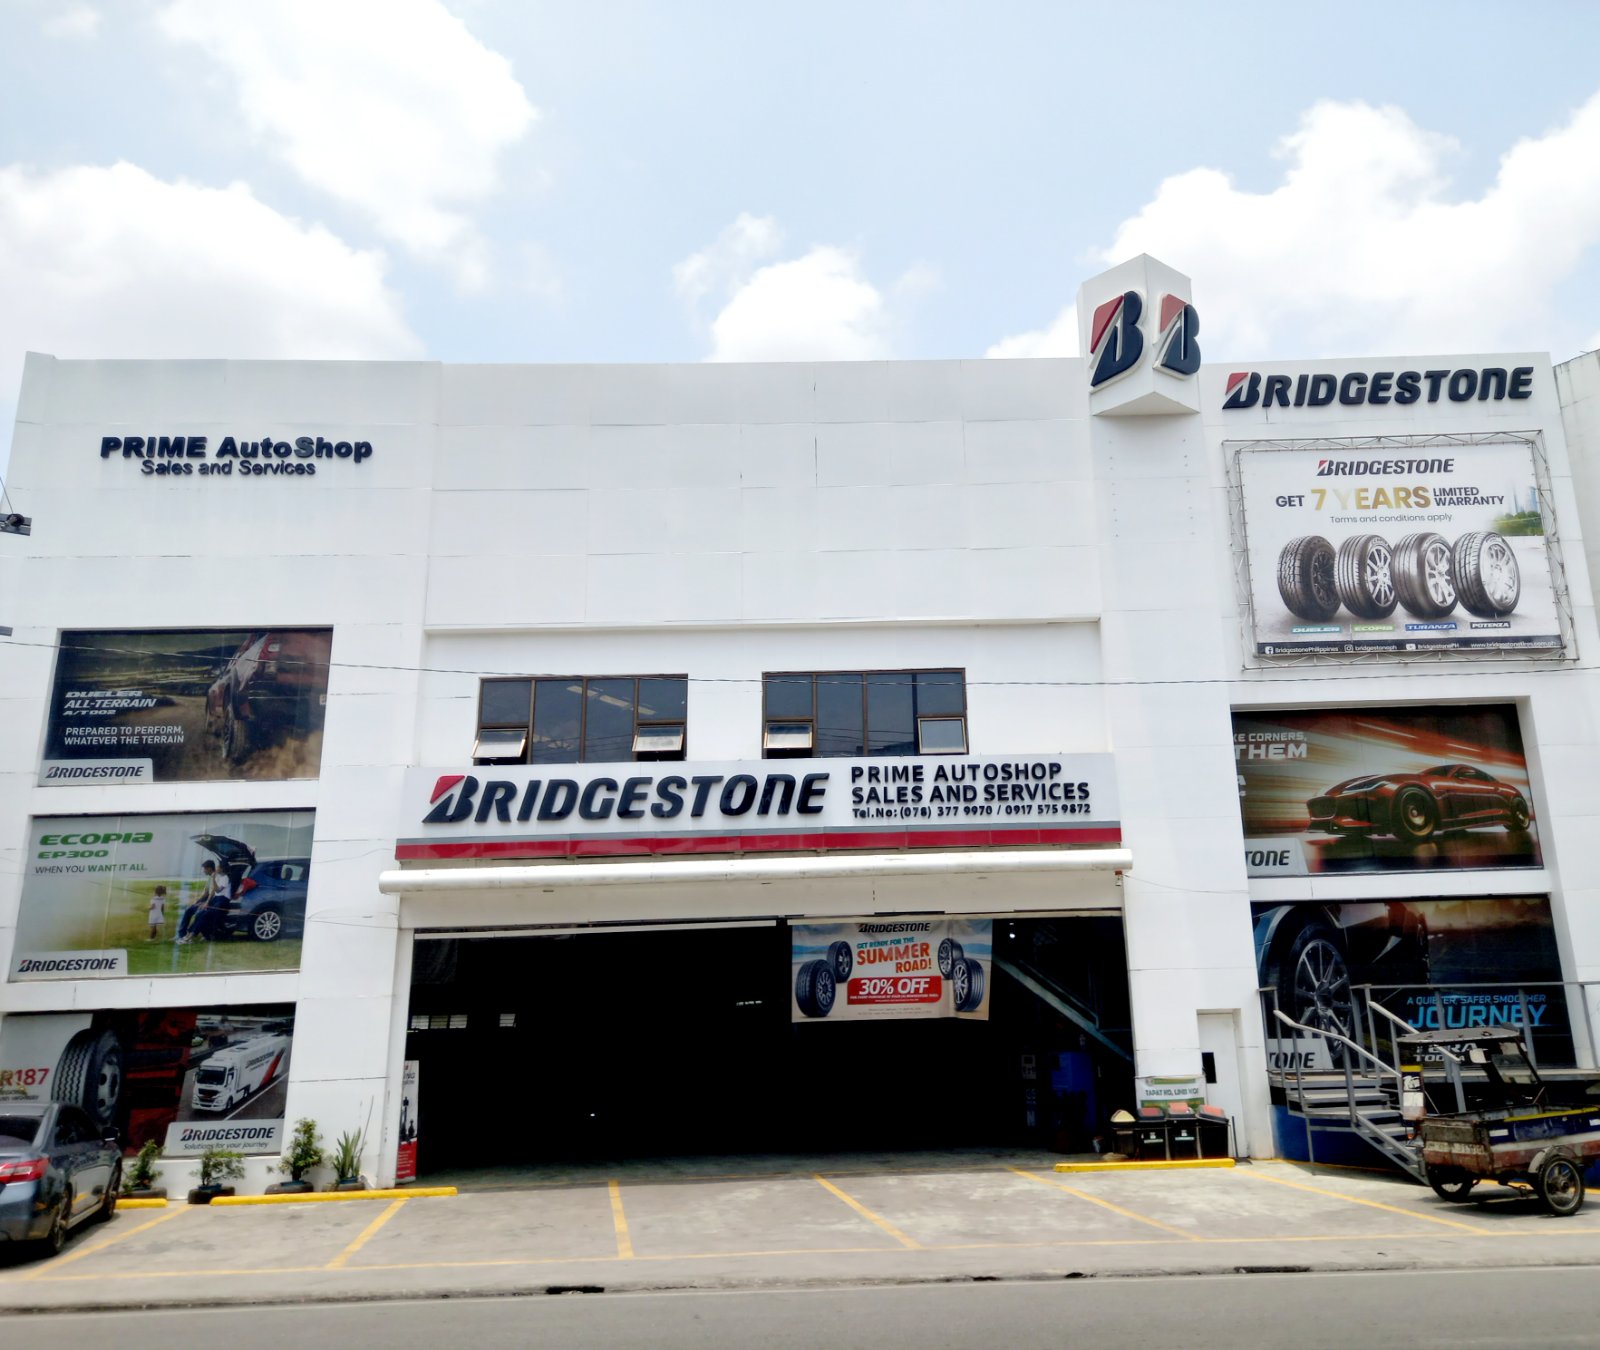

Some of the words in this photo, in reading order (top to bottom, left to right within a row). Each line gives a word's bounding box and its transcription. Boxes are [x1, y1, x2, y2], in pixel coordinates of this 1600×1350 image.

[1222, 366, 1534, 409] BRIDGESTONE
[100, 436, 207, 458] PRIME
[216, 436, 373, 463] AutoShop
[141, 459, 193, 476] Sales
[198, 459, 232, 475] and
[239, 459, 316, 475] Services
[1317, 458, 1454, 476] BRIDGESTONE
[1276, 495, 1304, 507] GET
[1311, 489, 1327, 511] 7
[1332, 486, 1431, 510] YEARS
[1433, 487, 1479, 497] LIMITED
[1434, 496, 1504, 507] WARRANTY
[1359, 514, 1377, 523] and
[1379, 513, 1425, 522] conditions
[1427, 512, 1452, 523] apply
[65, 690, 143, 698] DUELER
[64, 698, 157, 708] ALL-TERRAIN
[65, 727, 117, 736] PREPARED
[120, 726, 132, 735] TO
[135, 725, 184, 735] PERFORM,
[1249, 731, 1307, 742] CORNERS,
[64, 736, 117, 745] WHATEVER
[120, 736, 139, 745] THE
[142, 735, 184, 744] TERRAIN
[1234, 743, 1308, 760] THEM
[45, 765, 145, 779] BRIDGESTONE
[851, 764, 925, 784] PRIME
[934, 762, 1062, 782] AUTOSHOP
[422, 773, 830, 824] BRIDGESTONE
[852, 785, 923, 804] SALES
[930, 784, 977, 803] AND
[984, 782, 1090, 802] SERVICES
[900, 805, 932, 820] (078)
[937, 806, 958, 817] 377
[963, 805, 993, 816] 9970
[1005, 804, 1033, 815] 0917
[1037, 803, 1058, 815] 575
[1061, 803, 1091, 814] 9872
[37, 849, 109, 859] EP300
[35, 865, 63, 874] WHEN
[65, 864, 85, 873] YOU
[87, 864, 117, 872] WANT
[129, 863, 148, 871] ALL.
[858, 922, 931, 933] BRIDGESTONE
[889, 938, 902, 946] FOR
[903, 936, 915, 944] THE
[856, 942, 930, 966] SUMMER
[17, 957, 119, 973] BRIDGESTONE
[895, 958, 932, 974] ROAD!
[859, 979, 894, 996] 30%
[898, 977, 930, 995] OFF
[1407, 996, 1414, 1006] A
[1415, 995, 1458, 1005] QUIEER,
[1493, 994, 1546, 1003] SMOOHER
[1408, 1004, 1548, 1028] JOURNEY
[180, 1127, 275, 1141] BRIDGESTONE
[184, 1142, 214, 1150] Solutions
[215, 1142, 225, 1150] for
[241, 1142, 268, 1150] journey
